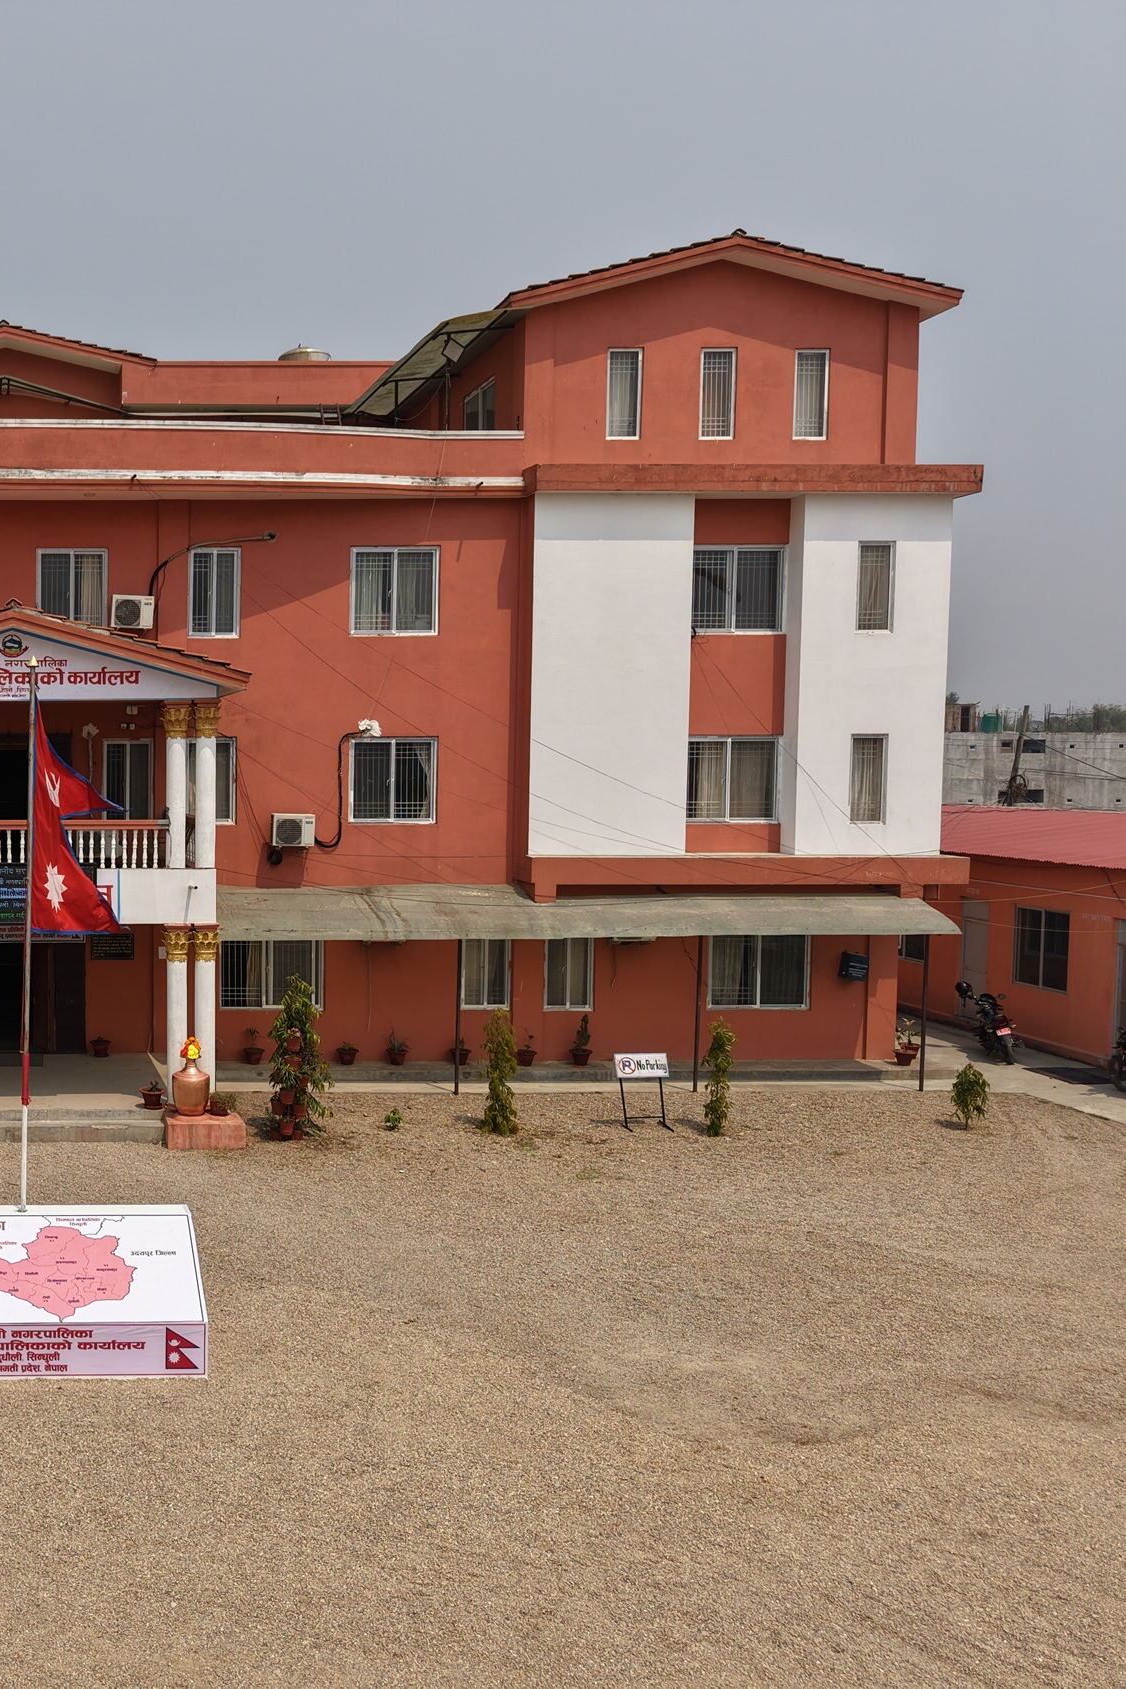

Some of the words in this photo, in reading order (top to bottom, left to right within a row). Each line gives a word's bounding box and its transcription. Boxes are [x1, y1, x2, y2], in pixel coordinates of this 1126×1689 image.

[67, 666, 141, 686] कार्यालय
[636, 1060, 646, 1071] No
[645, 1059, 668, 1074] Parking
[11, 1327, 94, 1339] नगरपालिका
[77, 1339, 146, 1351] कार्यालय
[27, 1351, 61, 1363] सिन्धुली
[44, 1362, 68, 1373] नेपाल
